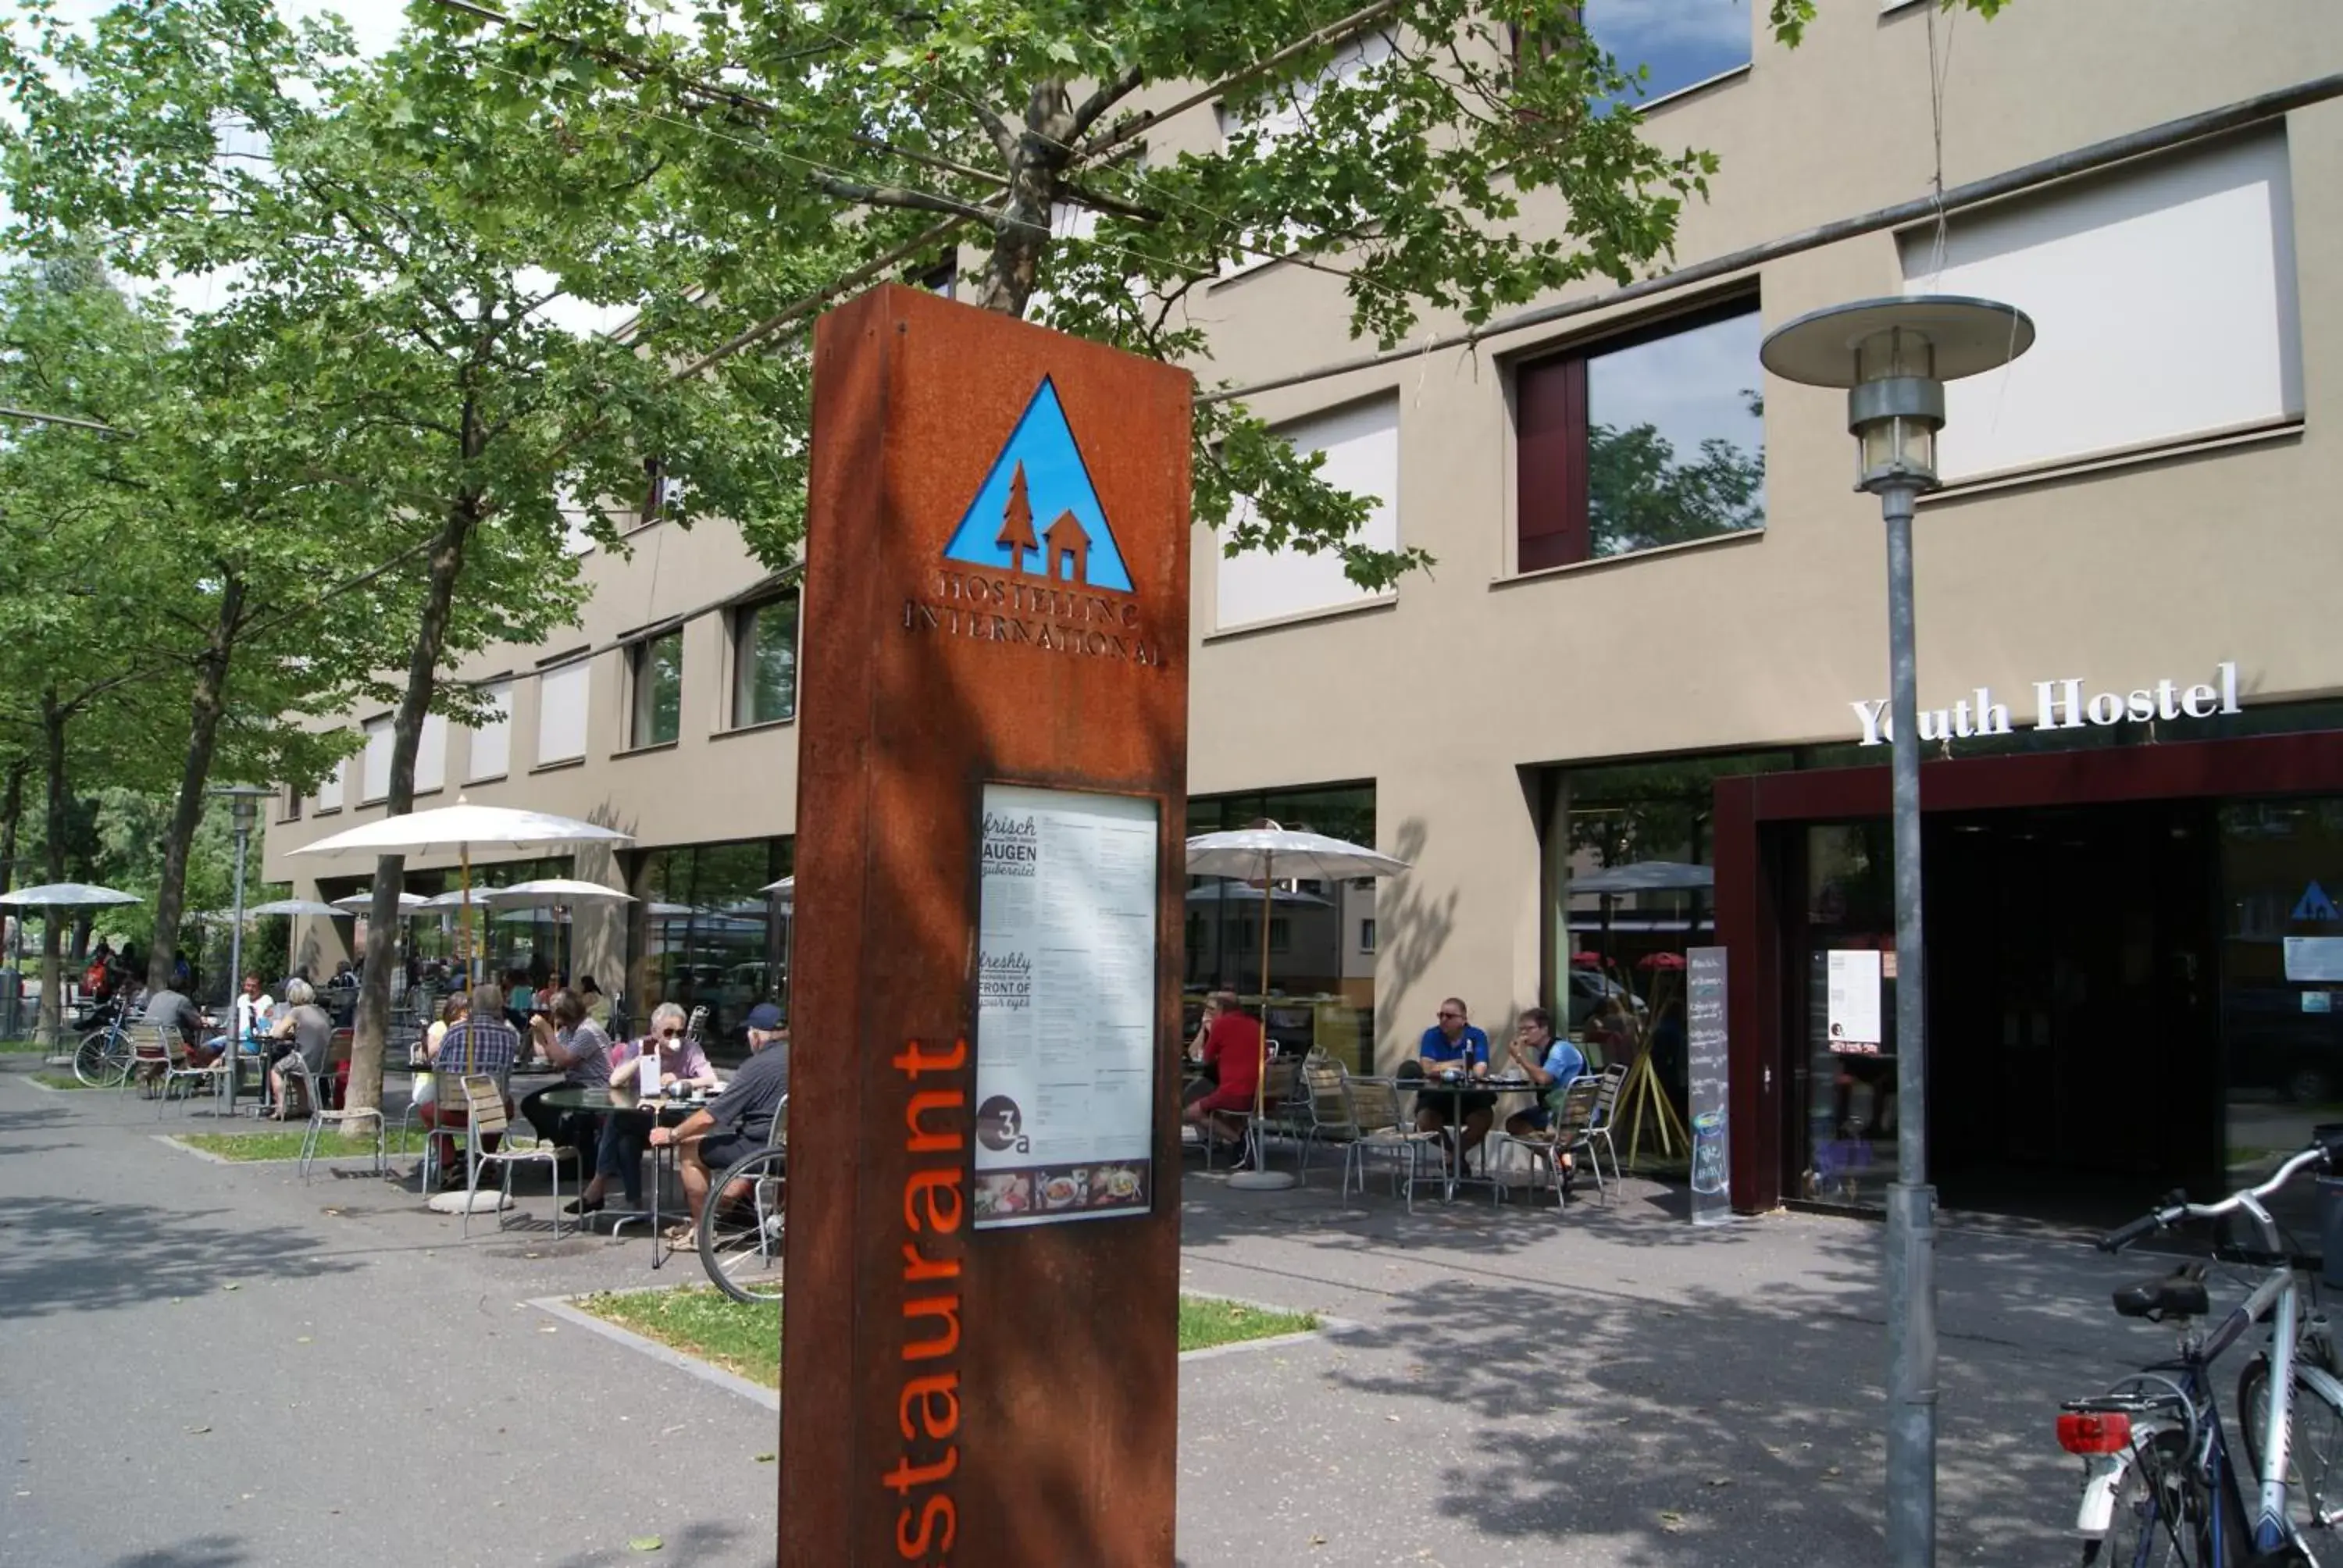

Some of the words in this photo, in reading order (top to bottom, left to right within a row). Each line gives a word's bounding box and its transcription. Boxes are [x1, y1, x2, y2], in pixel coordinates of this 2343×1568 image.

[937, 569, 1140, 629] HOSTELLING
[903, 599, 1165, 667] INTERNATIONAL
[2033, 661, 2243, 731] Hostel
[983, 843, 1037, 861] AUGEN
[979, 982, 1015, 994] FRONT
[1016, 982, 1032, 994] OF
[883, 1036, 967, 1568] staurant
